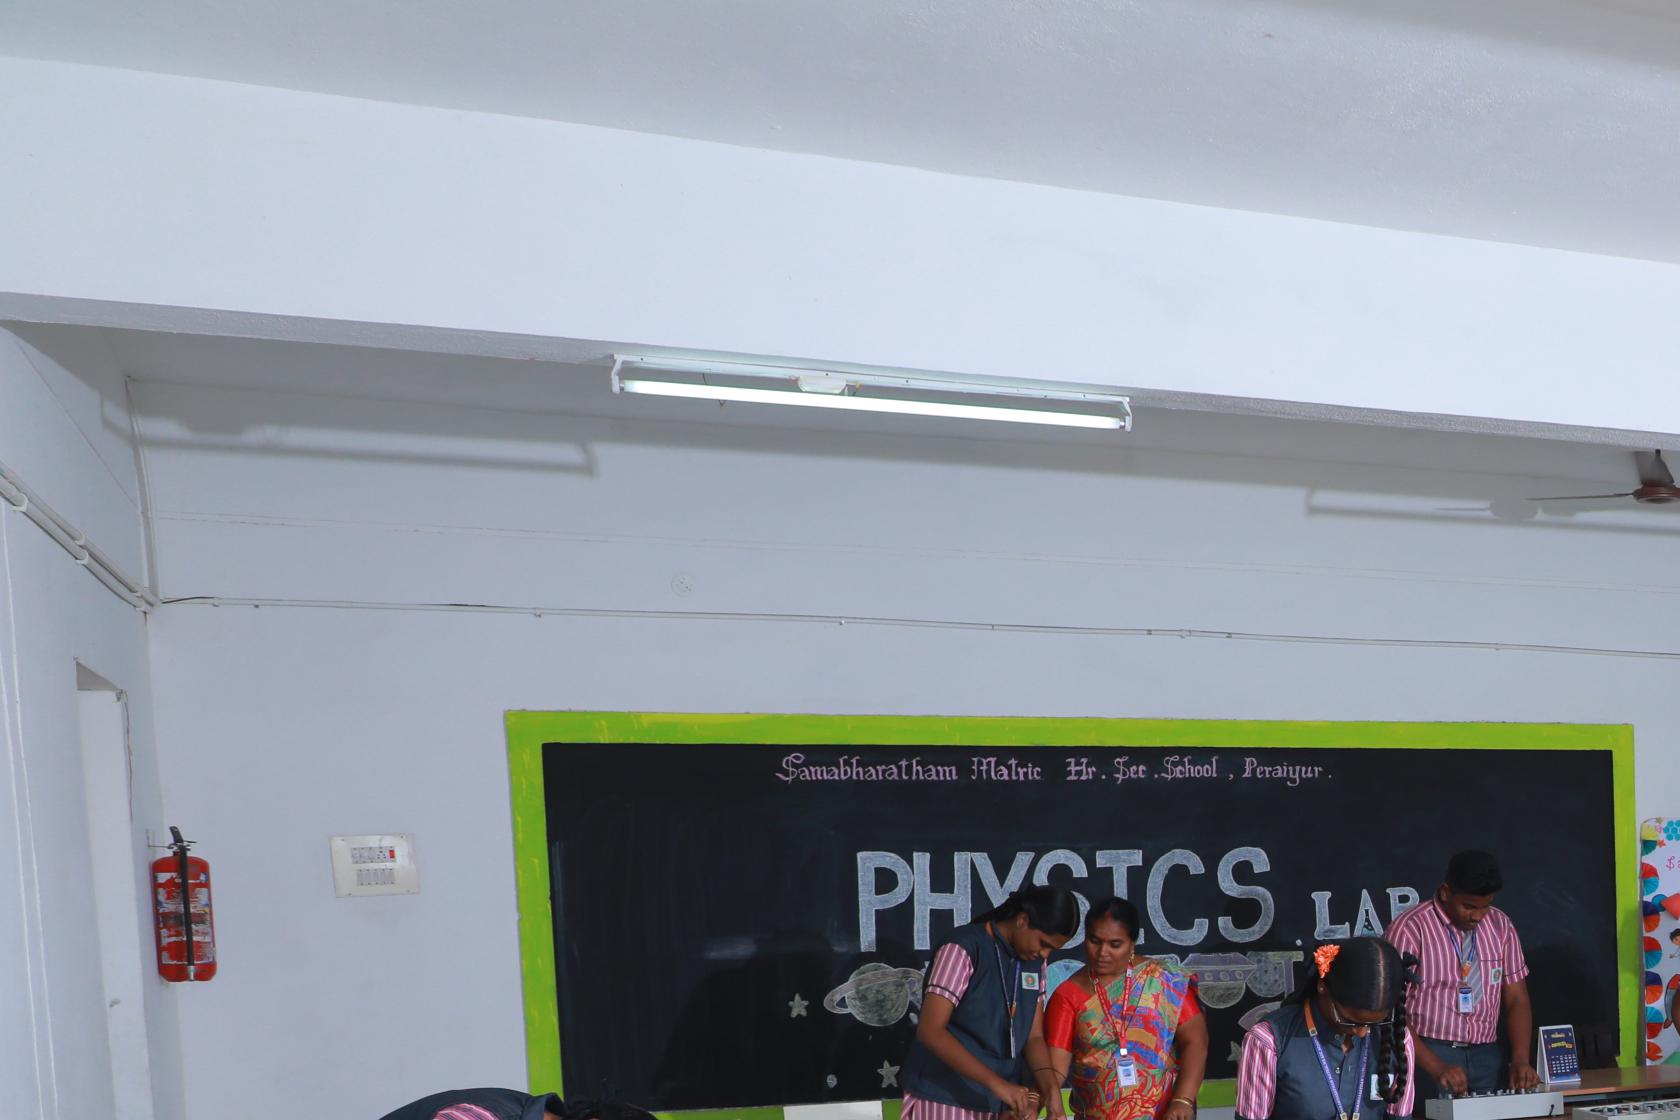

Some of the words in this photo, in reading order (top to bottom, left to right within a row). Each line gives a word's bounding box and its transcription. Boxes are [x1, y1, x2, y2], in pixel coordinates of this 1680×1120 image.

[776, 753, 958, 784] Samabharatham
[971, 757, 1042, 781] Matric
[857, 846, 1275, 953] PHYSICS
